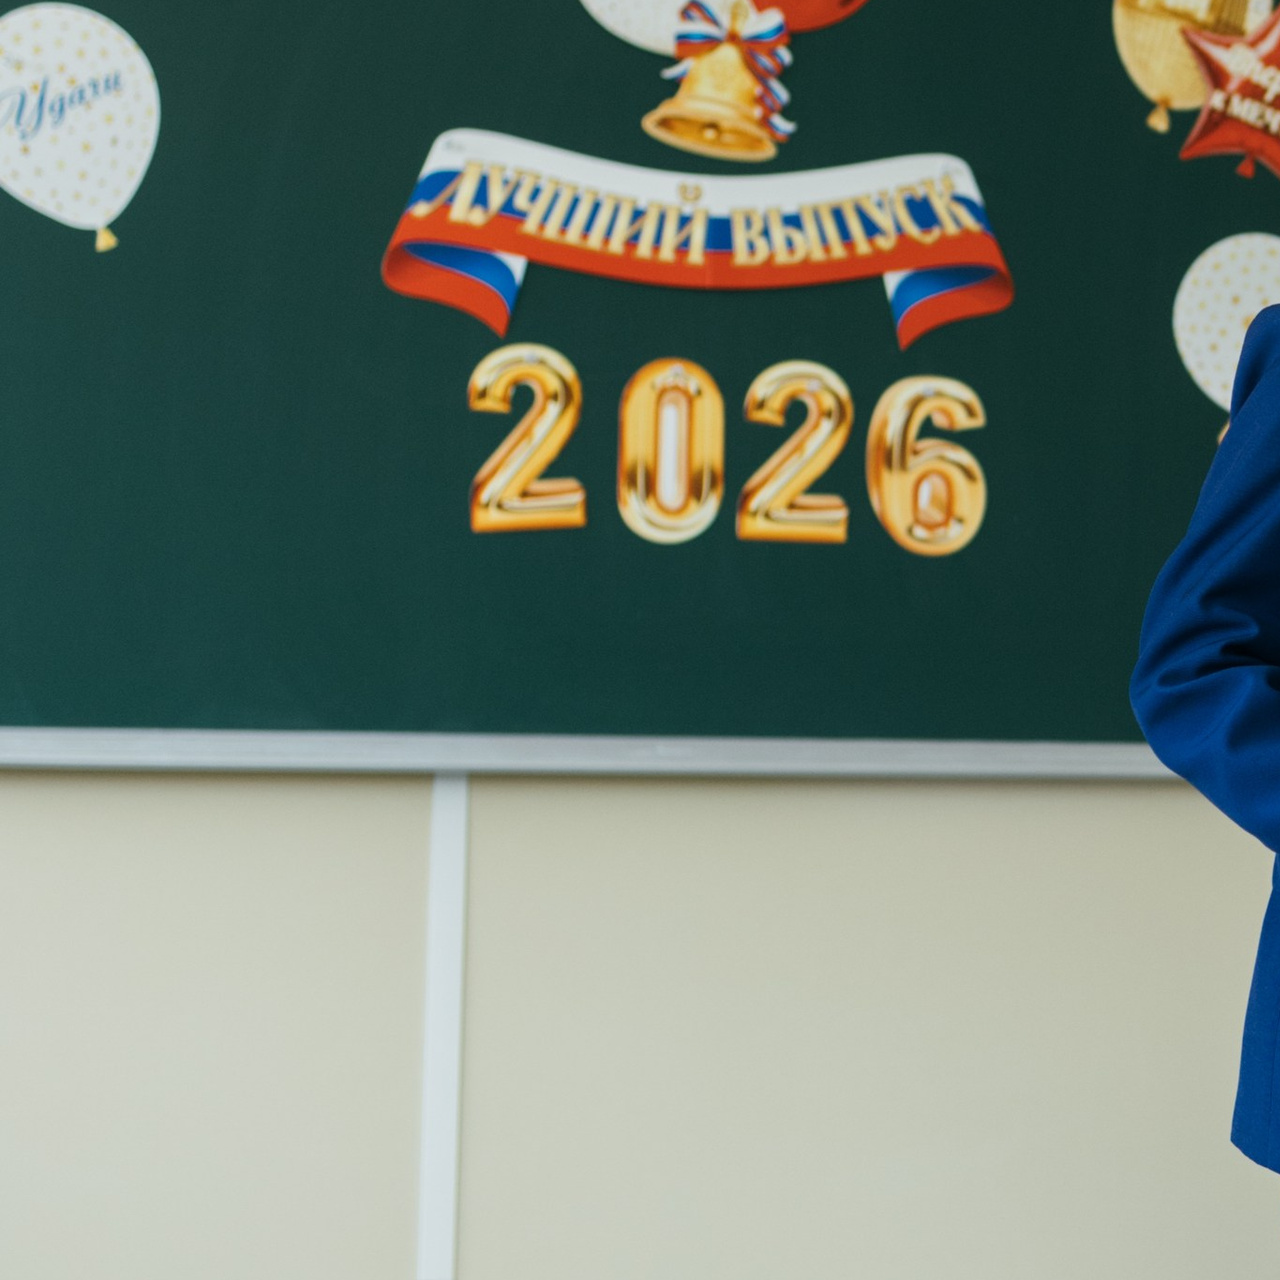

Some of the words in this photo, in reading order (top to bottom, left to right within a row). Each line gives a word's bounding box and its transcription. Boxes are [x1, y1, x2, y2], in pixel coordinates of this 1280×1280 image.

[409, 160, 709, 266] ЛУЧШИЙ
[729, 173, 984, 267] ВЫПУСК
[467, 342, 988, 557] 2026
